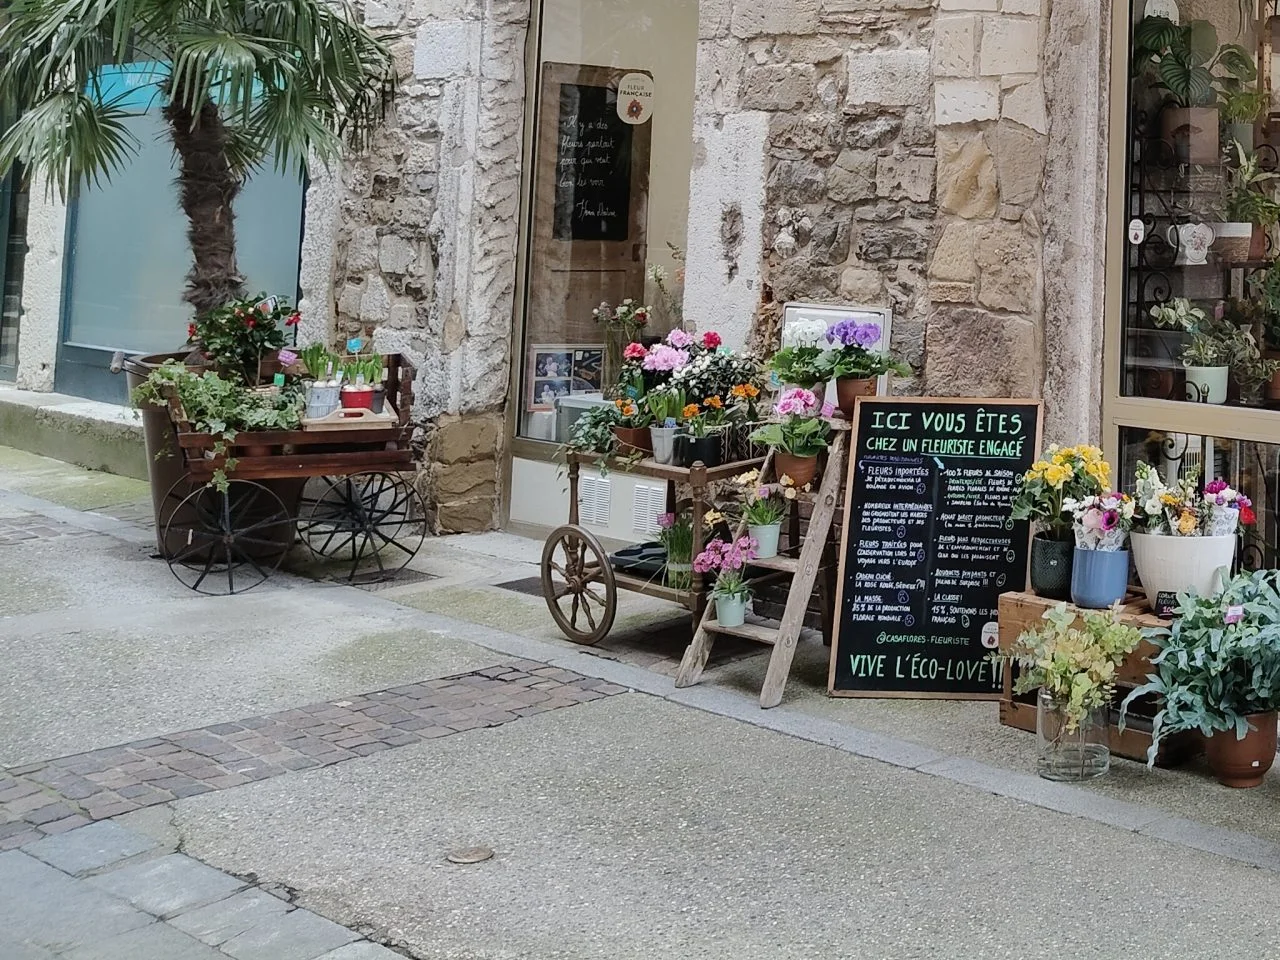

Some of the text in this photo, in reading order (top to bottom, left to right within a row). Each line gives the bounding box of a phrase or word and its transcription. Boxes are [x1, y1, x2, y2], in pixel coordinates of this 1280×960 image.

[619, 90, 653, 98] FRANÇAISE
[585, 135, 615, 155] partout
[870, 407, 1022, 435] ICI VOUS ÊTES
[866, 435, 1027, 457] CHEZ UN FLEURISTE ENGAGÉ
[867, 466, 893, 475] FLEURS
[963, 468, 983, 477] FLEURS
[859, 539, 880, 548] FLEURS
[857, 548, 893, 557] CONSERVATION
[854, 594, 862, 603] LA
[933, 593, 941, 601] LA
[849, 654, 887, 678] VIVE
